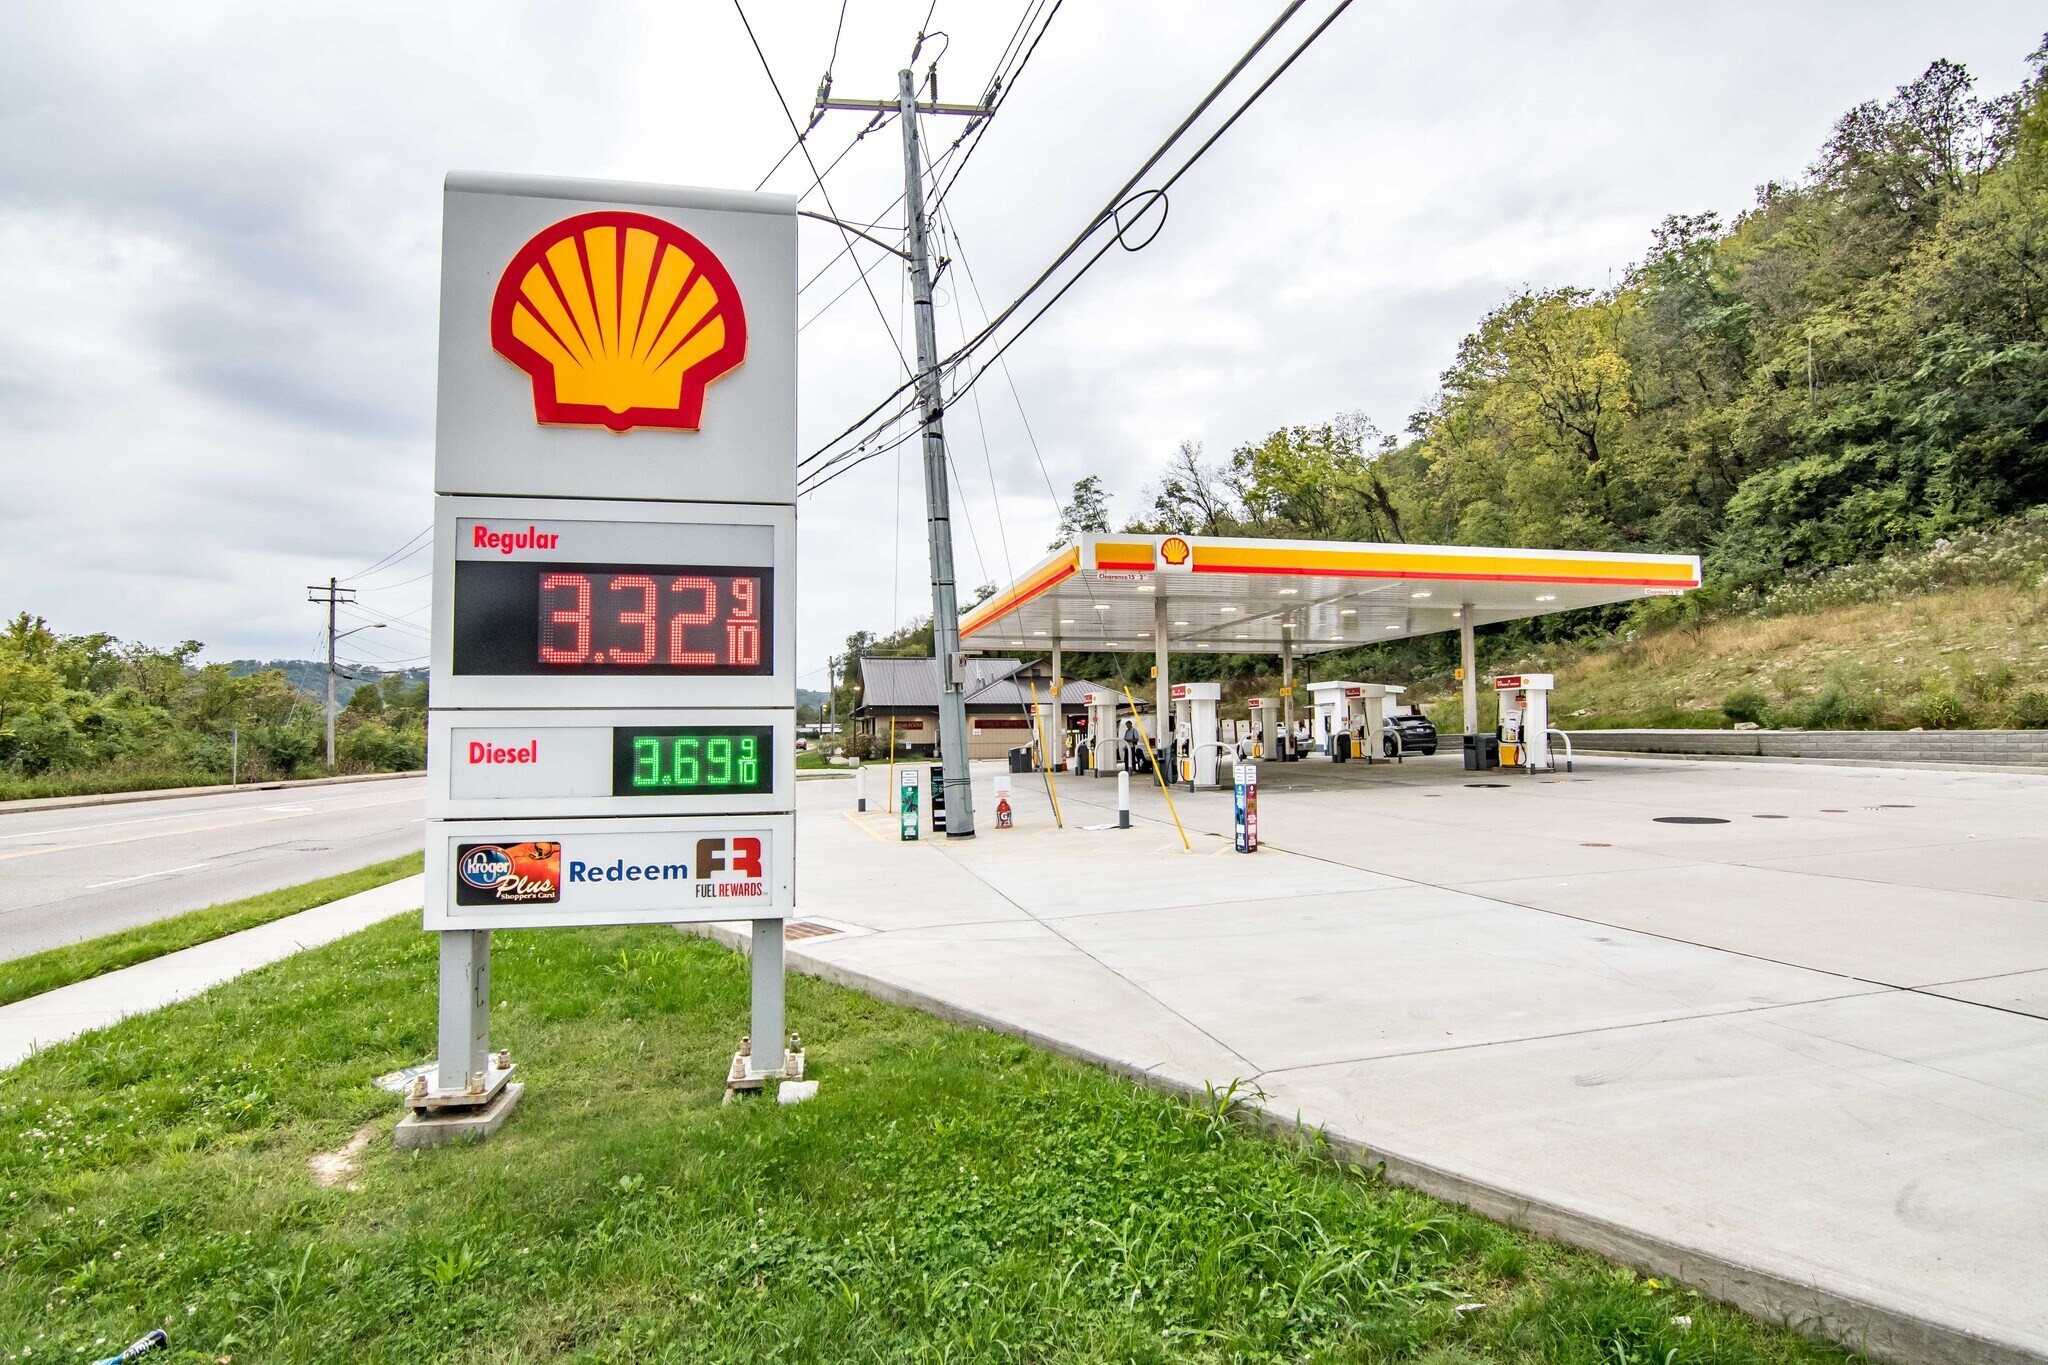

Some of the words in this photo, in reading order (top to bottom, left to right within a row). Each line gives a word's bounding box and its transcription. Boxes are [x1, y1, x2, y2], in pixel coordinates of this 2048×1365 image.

[474, 526, 558, 554] Regular
[542, 574, 717, 663] 3.32
[469, 740, 537, 764] Diesel
[633, 738, 732, 785] 3.69
[467, 853, 509, 882] Kroger
[569, 859, 688, 882] Redeem
[496, 874, 553, 898] Plus
[696, 884, 717, 898] FUEL
[718, 882, 762, 897] REWARDS
